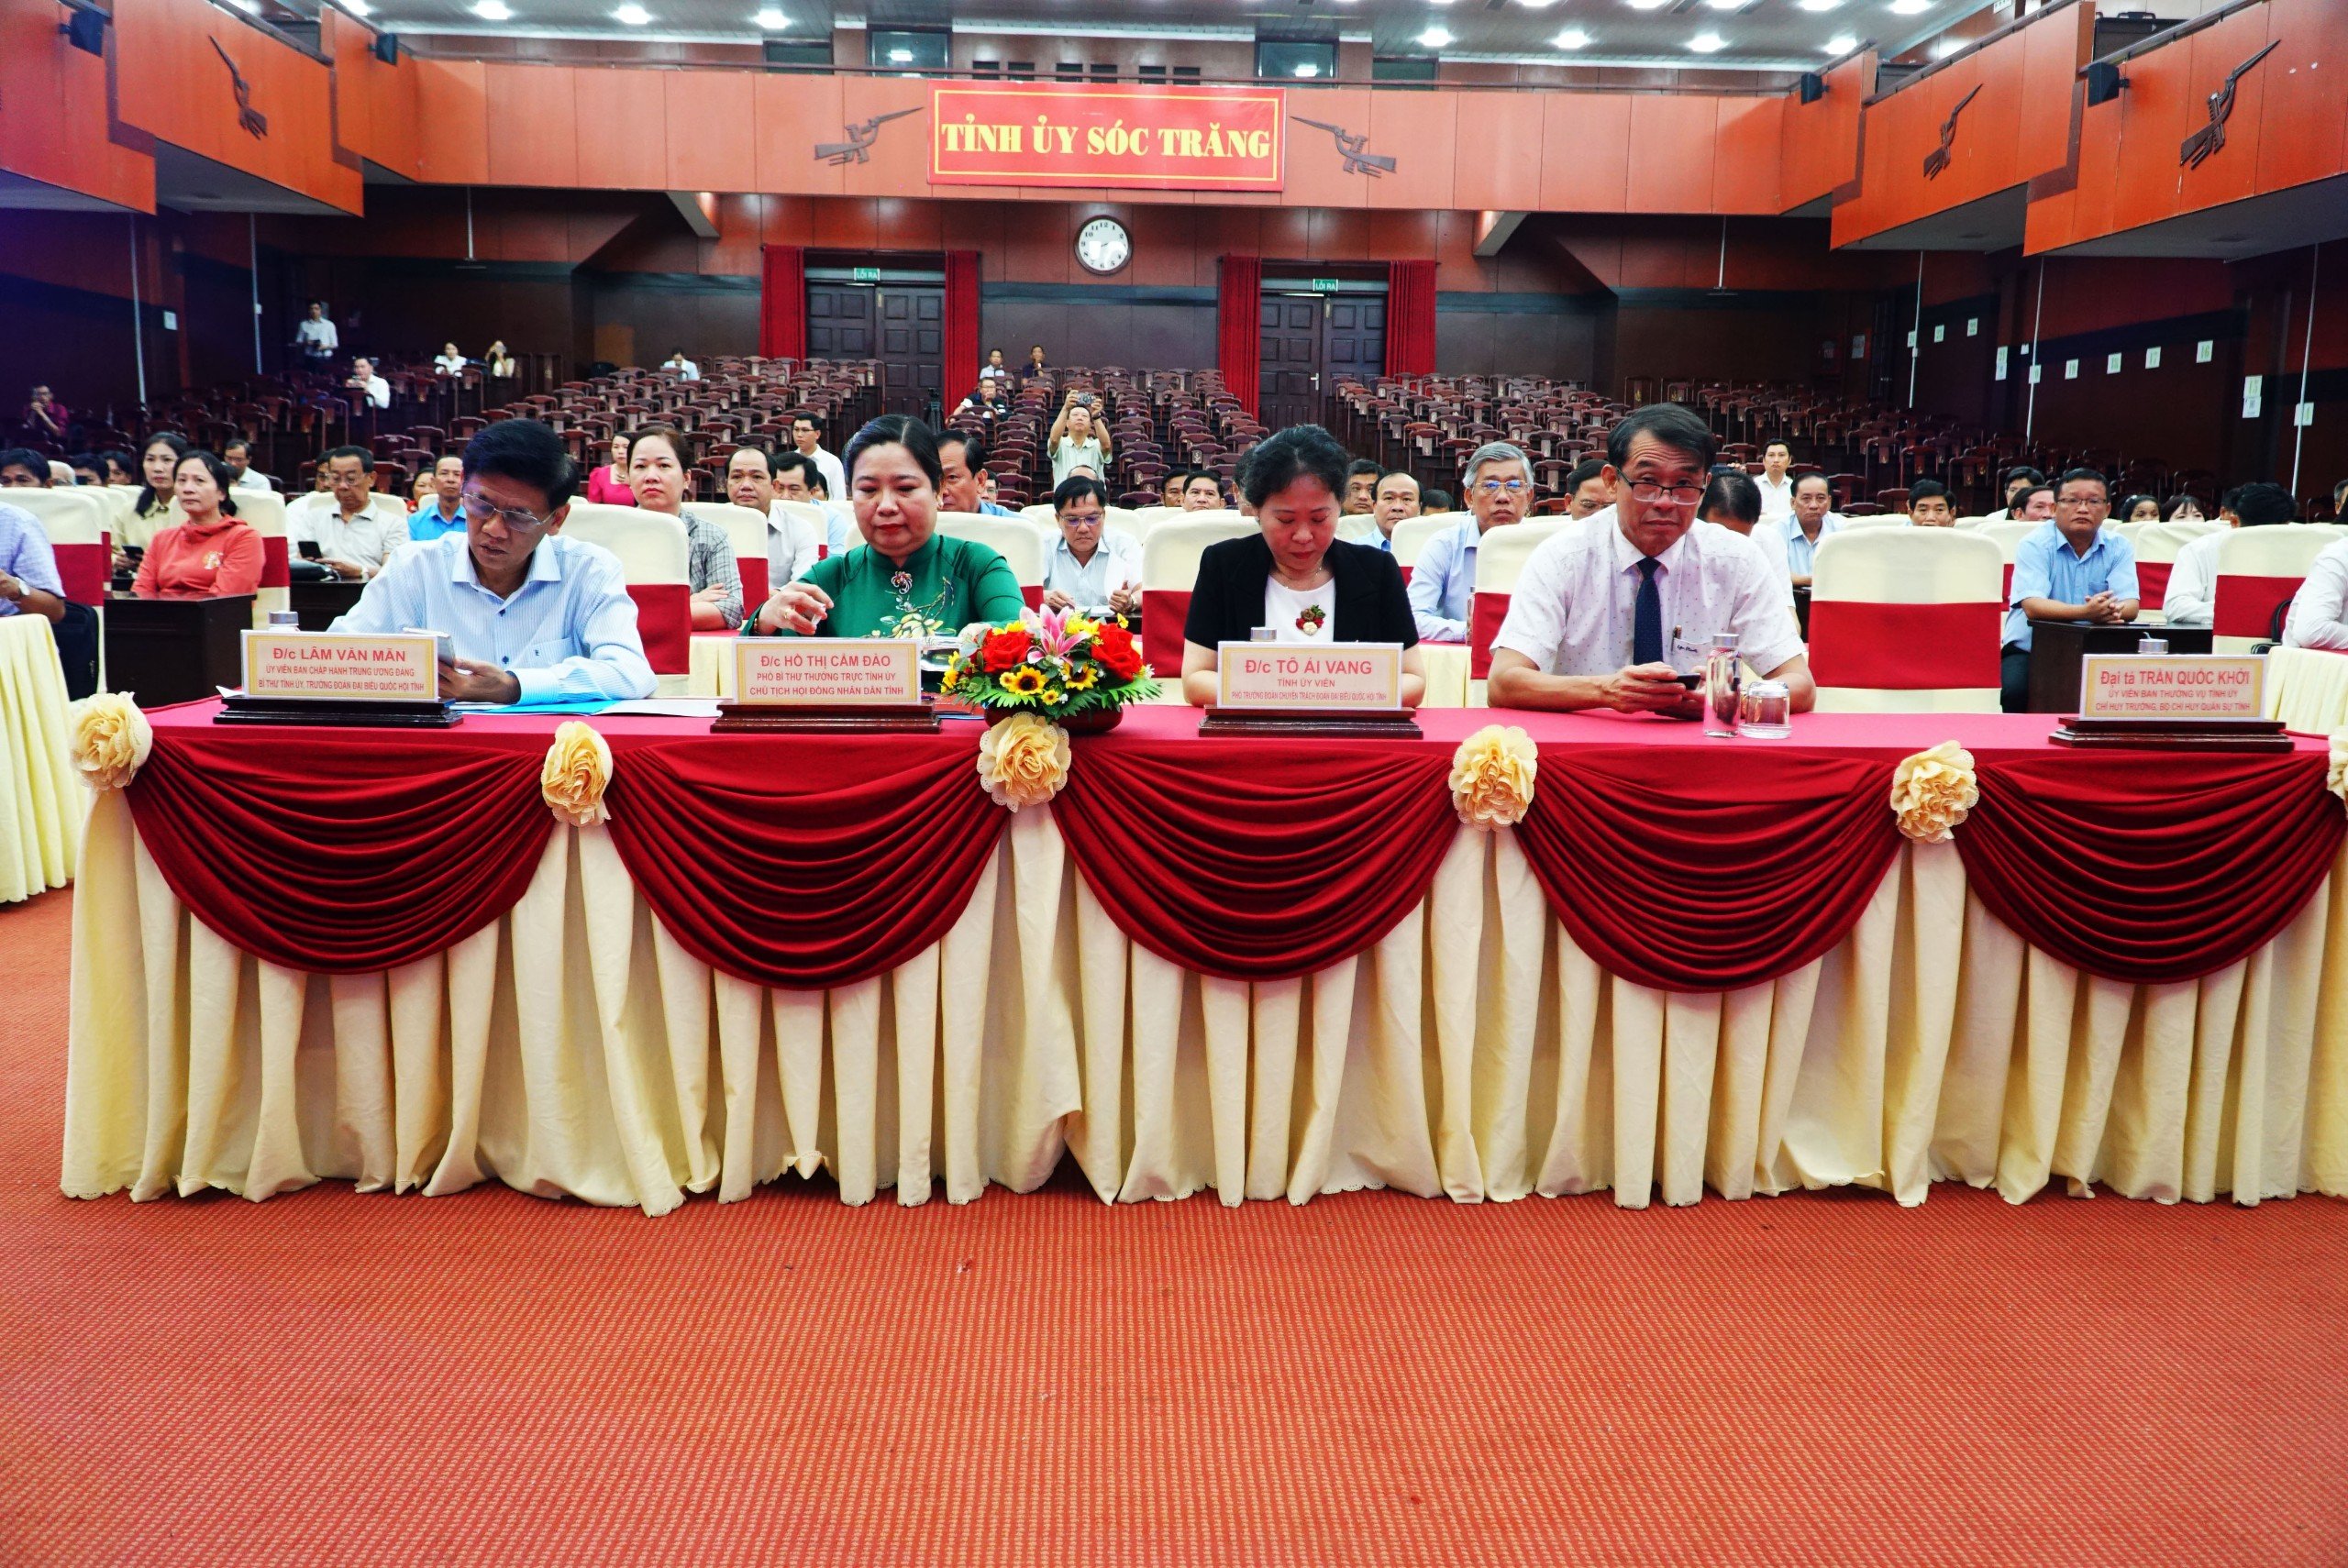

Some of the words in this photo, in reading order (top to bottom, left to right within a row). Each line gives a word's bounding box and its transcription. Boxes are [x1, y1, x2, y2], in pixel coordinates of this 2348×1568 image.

[942, 113, 1023, 153] TỈNH
[1033, 115, 1079, 155] ỦY
[1087, 119, 1149, 156] SÓC
[1157, 123, 1270, 159] TRĂNG
[1326, 282, 1336, 291] RA
[273, 647, 296, 659] Đ/c
[301, 646, 332, 660] LÂM
[337, 647, 368, 661] VĂN
[761, 656, 781, 667] Đ/c
[784, 653, 803, 667] HỒ
[806, 656, 827, 669] THỊ
[863, 653, 891, 667] ĐÀO
[1245, 659, 1271, 674] Đ/c
[1277, 657, 1299, 674] TÔ
[1303, 657, 1320, 674] ÁI
[1325, 660, 1372, 675] VANG
[277, 664, 292, 674] VIÊN
[294, 666, 307, 674] BAN
[309, 664, 327, 675] CHẤP
[328, 665, 348, 675] HÀNH
[349, 667, 372, 676] TRUNG
[757, 671, 774, 681] PHÓ
[786, 672, 803, 681] THƯ
[804, 671, 839, 681] THƯỜNG
[841, 672, 863, 682] TRỰC
[865, 671, 883, 681] TỈNH
[2101, 670, 2121, 688] Đại
[2124, 671, 2135, 684] tá
[2140, 668, 2173, 684] TRẦN
[2177, 668, 2214, 685] QUỐC
[2219, 668, 2250, 684] KHỞI
[266, 679, 280, 688] THƯ
[353, 681, 363, 691] ĐẠI
[380, 680, 397, 690] QUỐC
[1277, 678, 1298, 687] TỈNH
[1315, 678, 1335, 688] VIÊN
[750, 686, 769, 695] CHỦ
[770, 687, 791, 697] TỊCH
[792, 686, 807, 697] HỘI
[810, 686, 835, 695] ĐỒNG
[836, 686, 861, 695] NHÂN
[863, 686, 882, 695] DÂN
[884, 685, 903, 695] TỈNH
[2121, 689, 2139, 697] VIÊN
[2109, 702, 2123, 711] HUY
[2185, 702, 2199, 711] HUY
